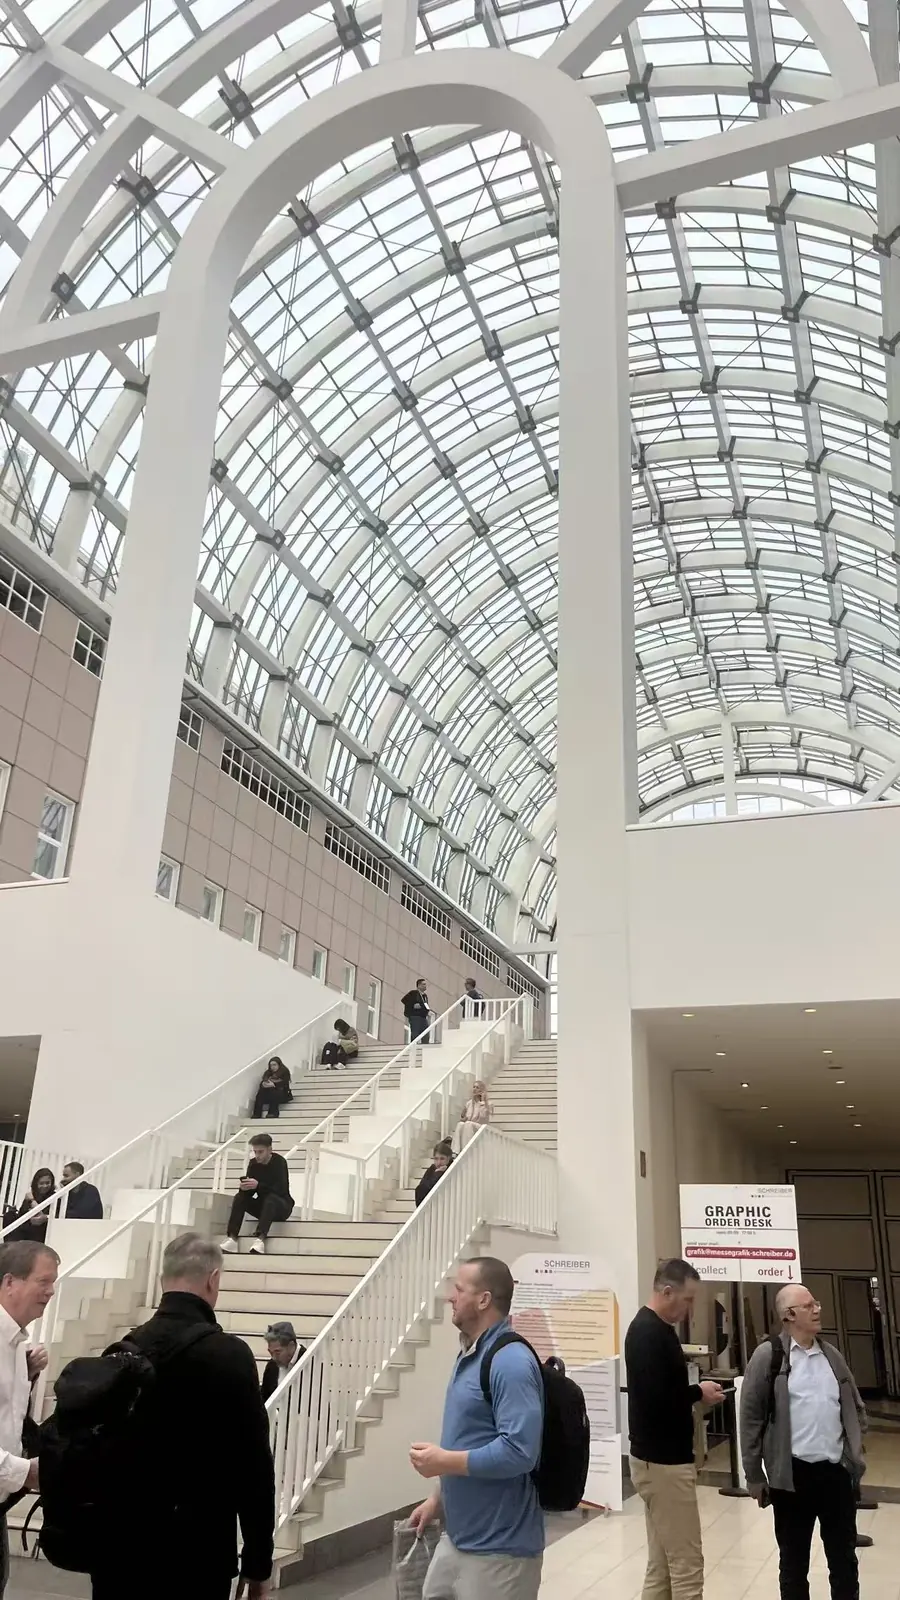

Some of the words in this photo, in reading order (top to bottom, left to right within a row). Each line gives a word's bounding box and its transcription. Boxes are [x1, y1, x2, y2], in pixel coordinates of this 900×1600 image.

[704, 1205, 771, 1218] GRAPHIC
[705, 1218, 740, 1227] ORDER
[744, 1218, 773, 1227] DESK
[686, 1248, 794, 1258] grafik@messegrafik-schreiber.de
[544, 1260, 591, 1269] SCHREIBER
[697, 1265, 728, 1275] collect
[757, 1267, 784, 1276] order
